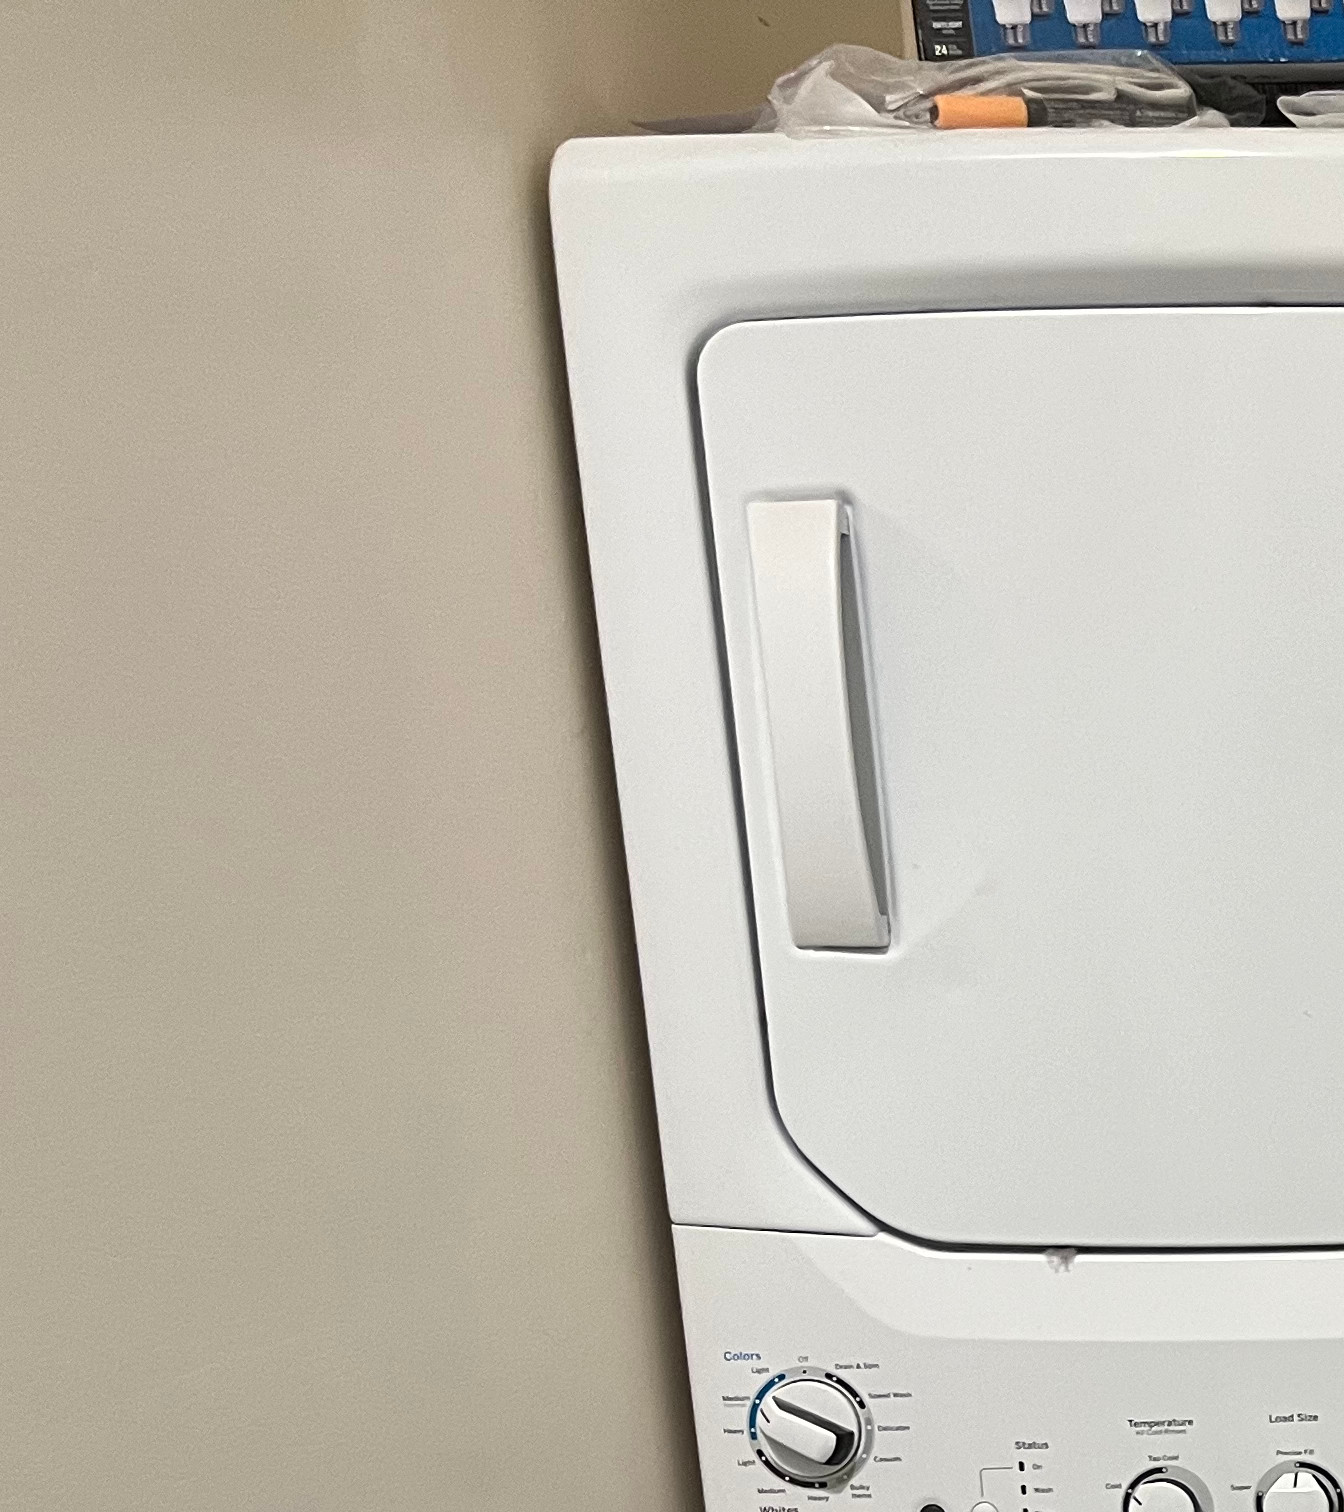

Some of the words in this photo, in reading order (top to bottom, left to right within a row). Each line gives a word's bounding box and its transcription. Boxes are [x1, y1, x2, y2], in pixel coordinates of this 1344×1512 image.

[934, 44, 948, 56] 24
[723, 1350, 762, 1361] Colors
[1127, 1418, 1194, 1429] Temperature
[1269, 1414, 1294, 1423] Load
[1297, 1413, 1319, 1422] Size
[1015, 1441, 1049, 1450] Status
